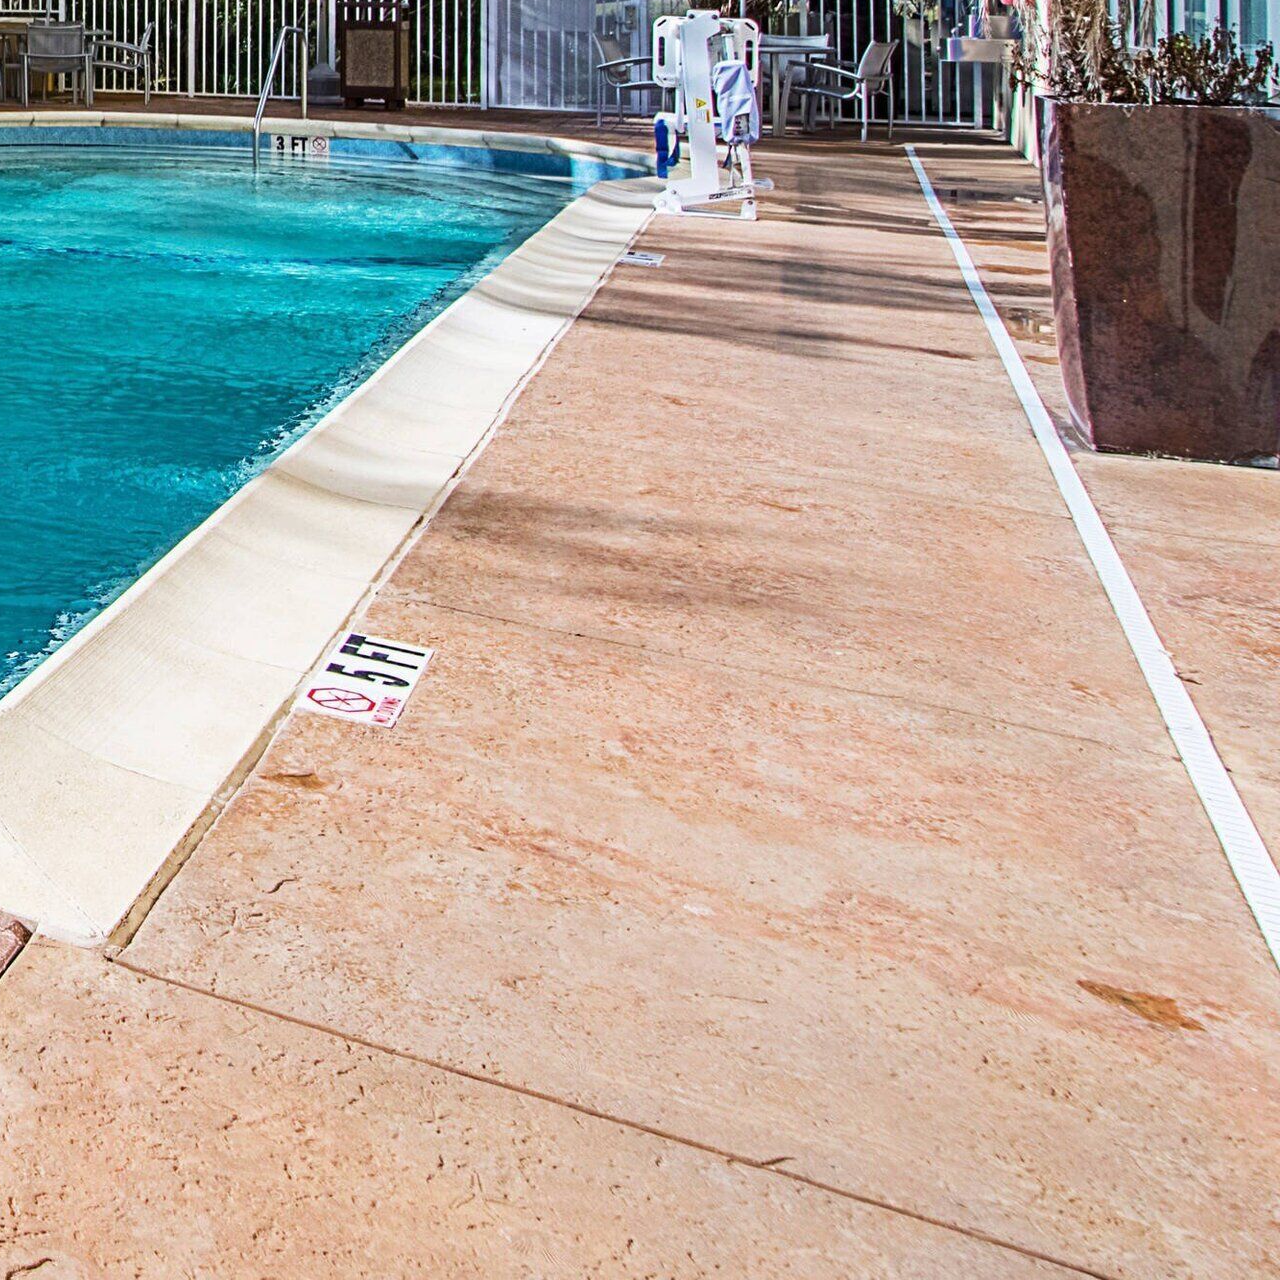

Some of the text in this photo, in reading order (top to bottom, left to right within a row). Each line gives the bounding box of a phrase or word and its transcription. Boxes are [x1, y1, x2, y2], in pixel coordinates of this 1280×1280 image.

[276, 136, 308, 151] 3 FT
[326, 633, 426, 687] 5 FT
